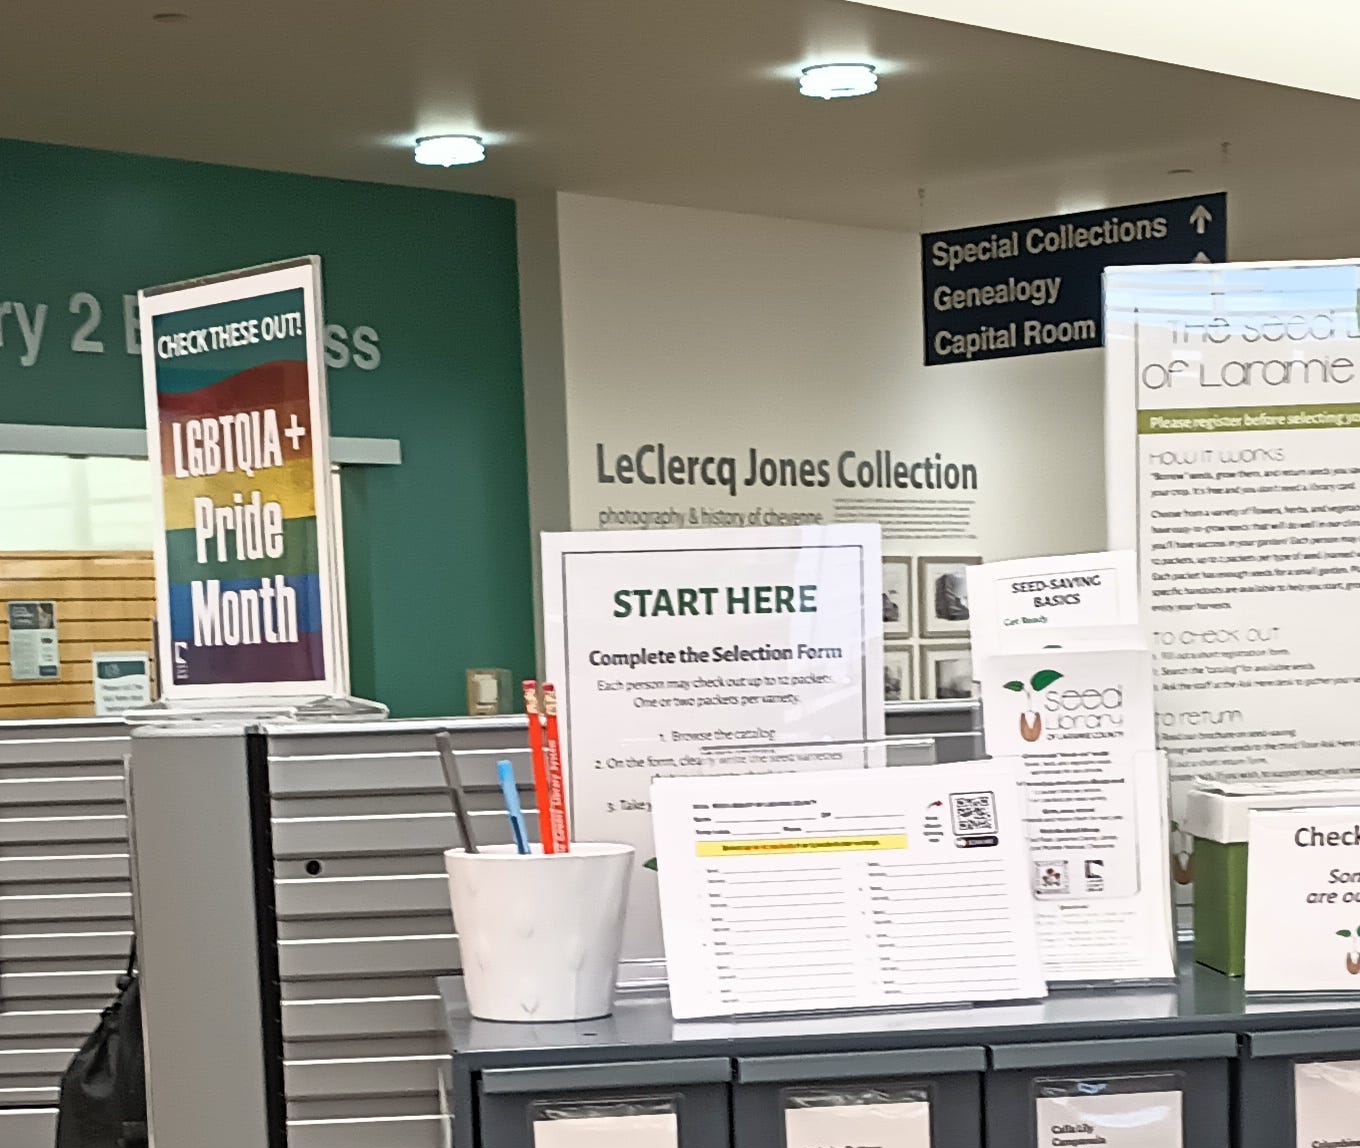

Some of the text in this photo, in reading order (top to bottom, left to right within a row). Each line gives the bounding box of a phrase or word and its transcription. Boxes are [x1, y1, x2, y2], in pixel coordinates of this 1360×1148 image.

[930, 212, 1169, 270] Special Collections
[933, 272, 1063, 314] Genealogy
[69, 292, 105, 354] 2
[156, 326, 211, 360] CHECK
[208, 318, 260, 350] THESE
[260, 312, 303, 340] OUT!
[934, 315, 1097, 360] Capital Room
[1141, 353, 1356, 390] of Laramie
[1150, 415, 1193, 429] Please
[1194, 414, 1243, 429] register
[1243, 413, 1285, 427] before
[1286, 411, 1341, 428] selecting
[596, 442, 979, 497] LeClercq Jones Collection
[193, 490, 285, 564] Pride
[598, 506, 686, 528] photography
[701, 507, 745, 528] history
[747, 507, 759, 525] of
[761, 507, 824, 527] cheyenne
[612, 584, 818, 618] START HERE
[1011, 574, 1102, 594] SEED-SAVING
[1033, 592, 1081, 608] BASICS
[190, 574, 299, 648] Month
[588, 643, 843, 668] Complete the Selection Form
[597, 678, 624, 691] Each
[625, 680, 665, 693] person
[666, 680, 690, 692] may
[692, 675, 725, 689] check
[633, 695, 659, 708] One
[672, 727, 777, 742] Browse the catalog
[1305, 890, 1339, 904] are
